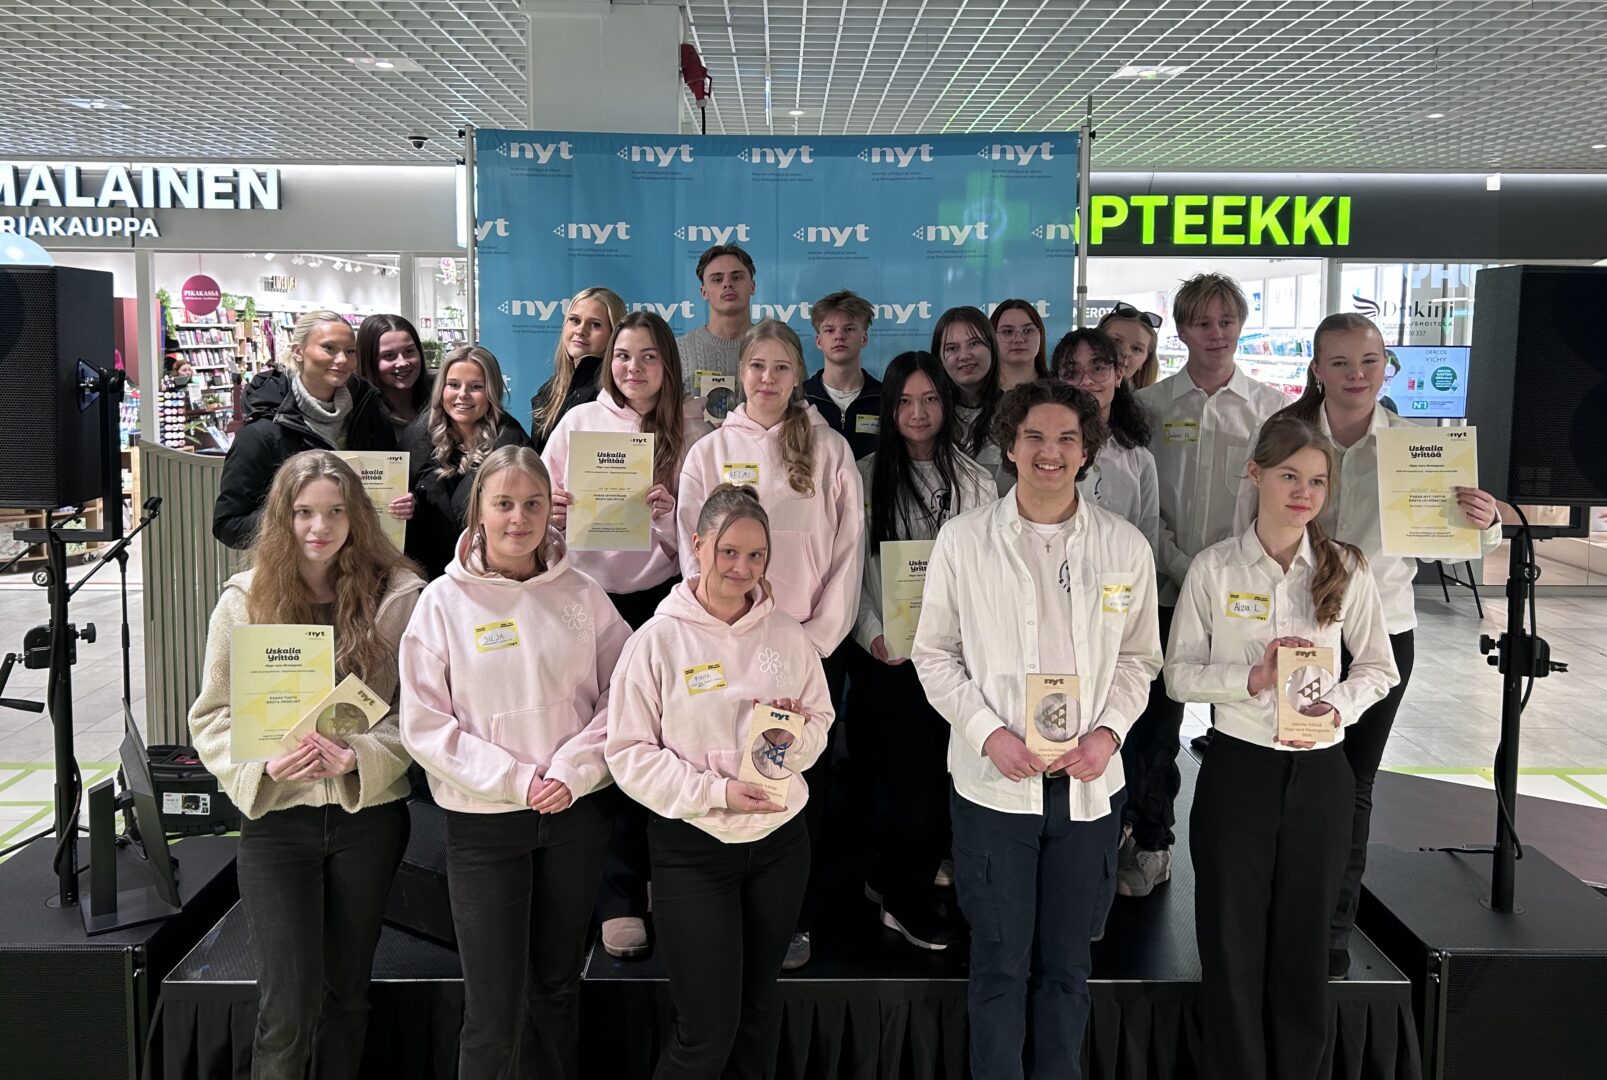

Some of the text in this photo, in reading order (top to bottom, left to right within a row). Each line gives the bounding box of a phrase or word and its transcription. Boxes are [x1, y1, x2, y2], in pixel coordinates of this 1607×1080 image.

[511, 141, 573, 164] nyt
[632, 144, 694, 168] nyt
[752, 145, 814, 169] nyt
[872, 143, 934, 167] nyt
[992, 142, 1054, 165] nyt
[1075, 195, 1351, 245] PTEEKKI
[568, 221, 630, 245] nyt
[688, 223, 750, 247] nyt
[808, 223, 870, 247] nyt
[927, 221, 989, 245] nyt
[1450, 431, 1467, 439] nyt
[1295, 650, 1317, 658] nyt
[1044, 678, 1065, 686] nyt
[357, 689, 376, 706] nyt
[770, 711, 790, 721] nyt
